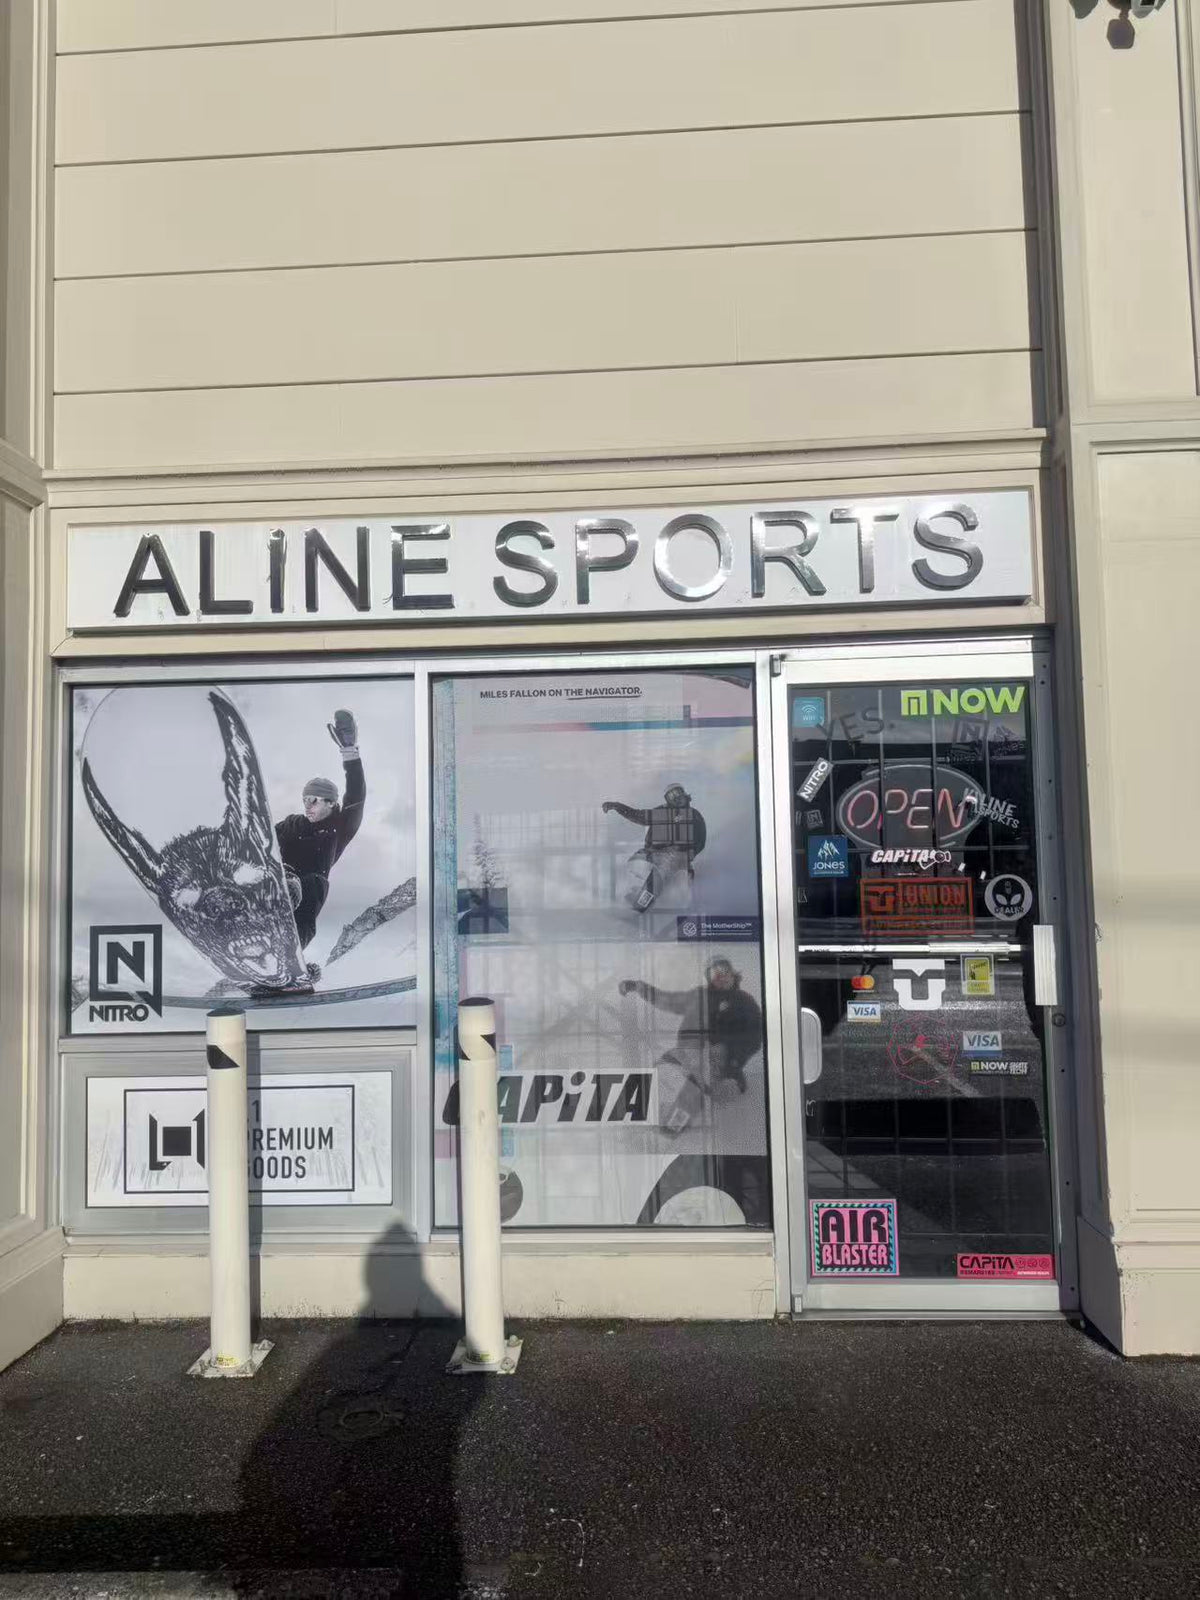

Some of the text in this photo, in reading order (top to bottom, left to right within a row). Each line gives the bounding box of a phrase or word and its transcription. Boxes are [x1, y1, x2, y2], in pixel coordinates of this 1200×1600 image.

[113, 501, 984, 617] ALINE SPORTS
[480, 686, 642, 699] MILES FALLON ON THE NAVIGATOR.
[932, 686, 1025, 715] NOW
[799, 761, 828, 799] NITRO
[847, 788, 965, 830] OPEN
[978, 808, 1020, 829] SPORTS
[89, 1004, 149, 1023] NITRO
[853, 1007, 877, 1016] VISA
[967, 1035, 999, 1047] VISA
[981, 1061, 1008, 1071] NOW
[247, 1127, 333, 1151] REMIUM
[821, 1209, 887, 1243] AIR
[822, 1244, 888, 1265] BLASTER
